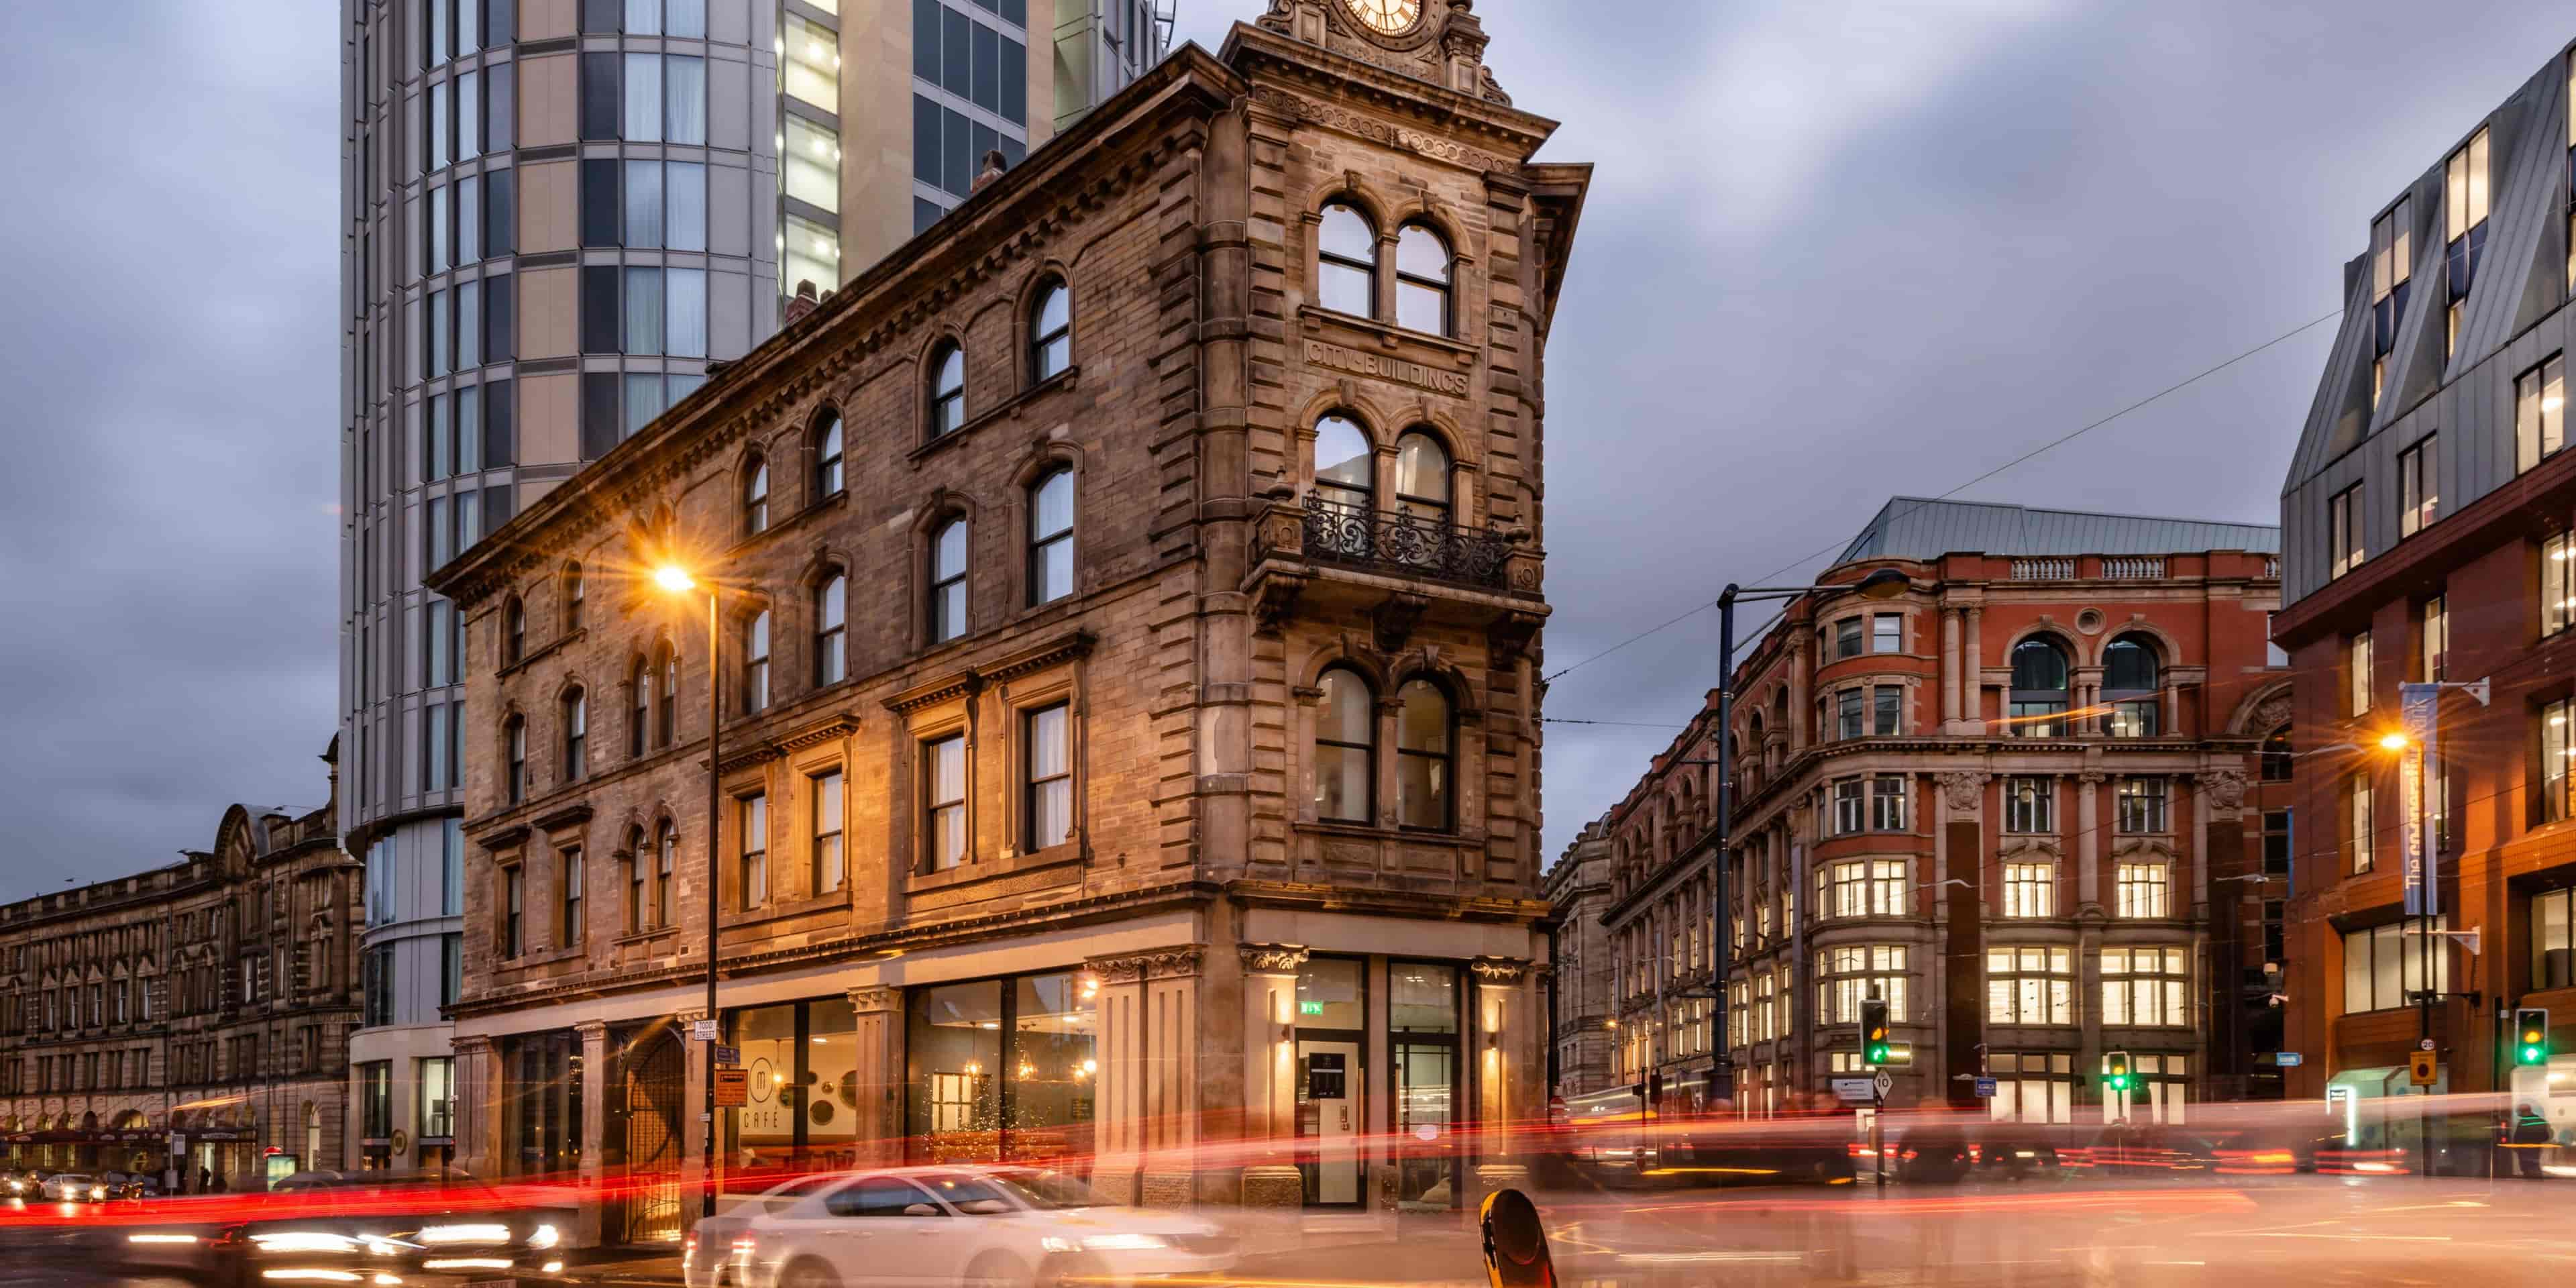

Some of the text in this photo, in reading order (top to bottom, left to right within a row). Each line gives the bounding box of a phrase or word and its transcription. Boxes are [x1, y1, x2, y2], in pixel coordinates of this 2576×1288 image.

[697, 1030, 715, 1039] STREET
[1878, 1078, 1889, 1087] 10
[745, 1106, 778, 1128] CAFÉ
